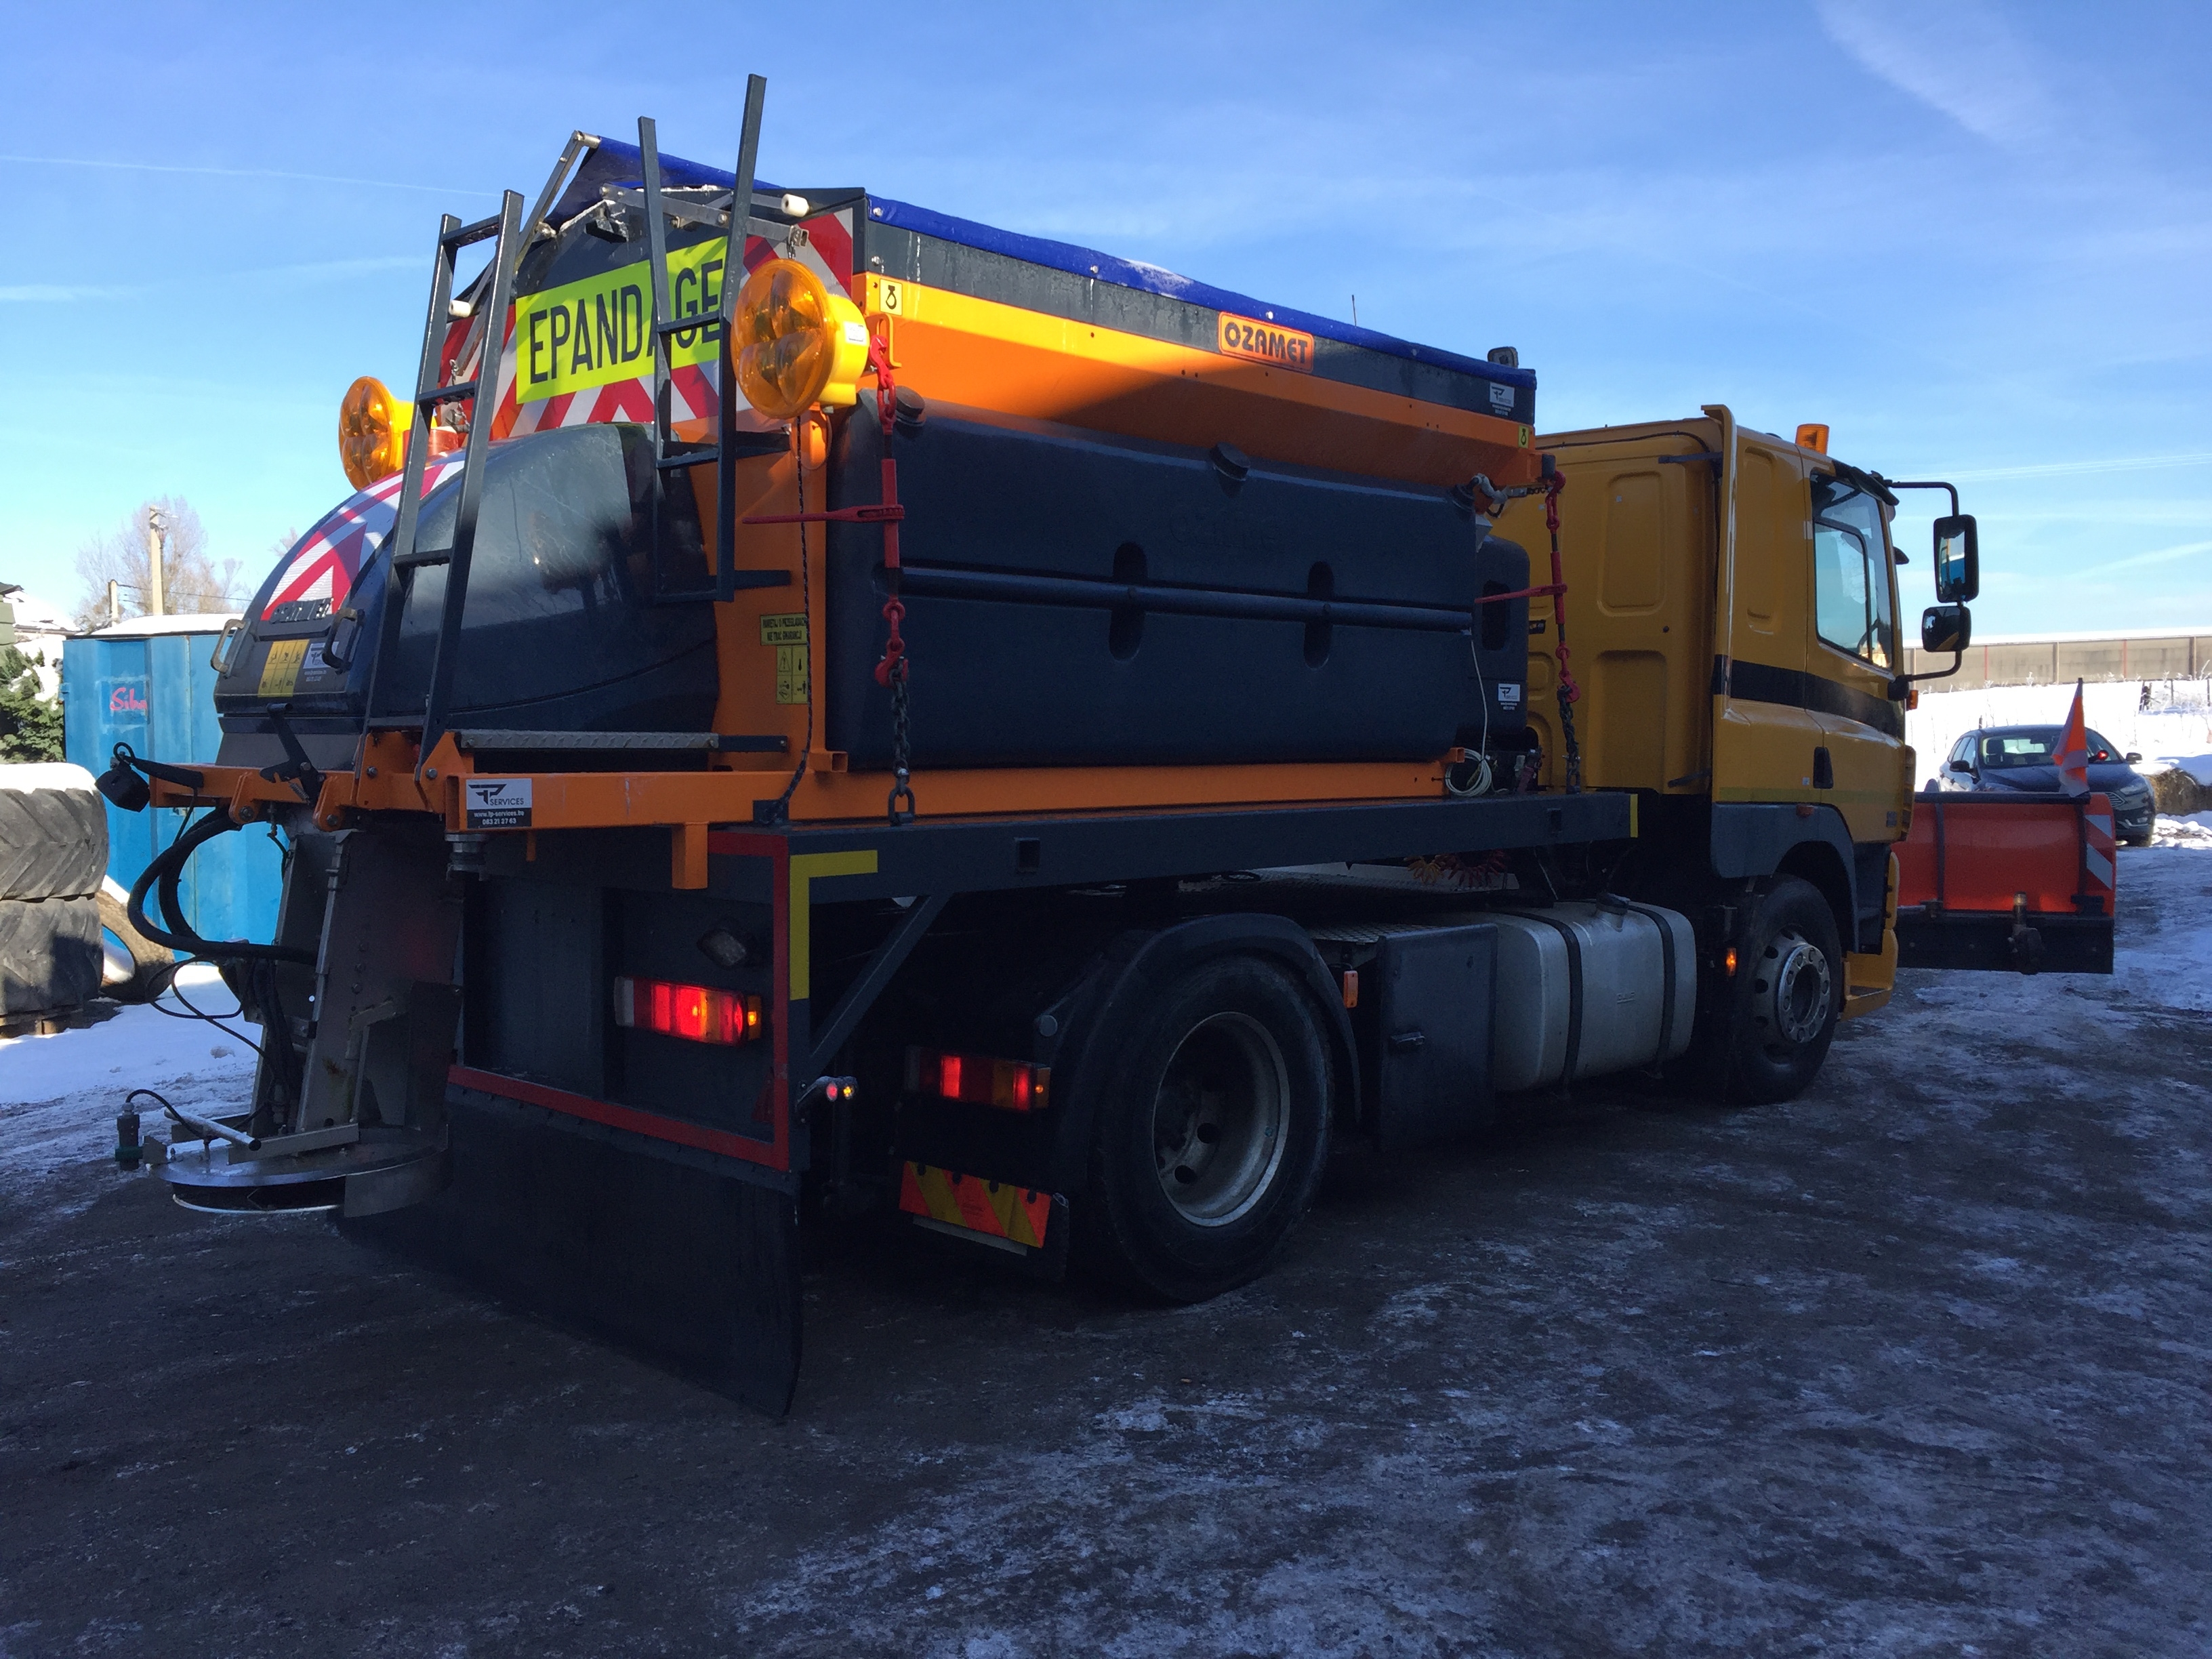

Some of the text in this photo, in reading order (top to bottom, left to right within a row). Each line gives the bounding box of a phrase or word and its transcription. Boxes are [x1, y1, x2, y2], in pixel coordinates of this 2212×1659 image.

[529, 258, 723, 384] EPANDGE
[1224, 321, 1308, 364] OZAMET
[490, 798, 525, 806] SERVICES
